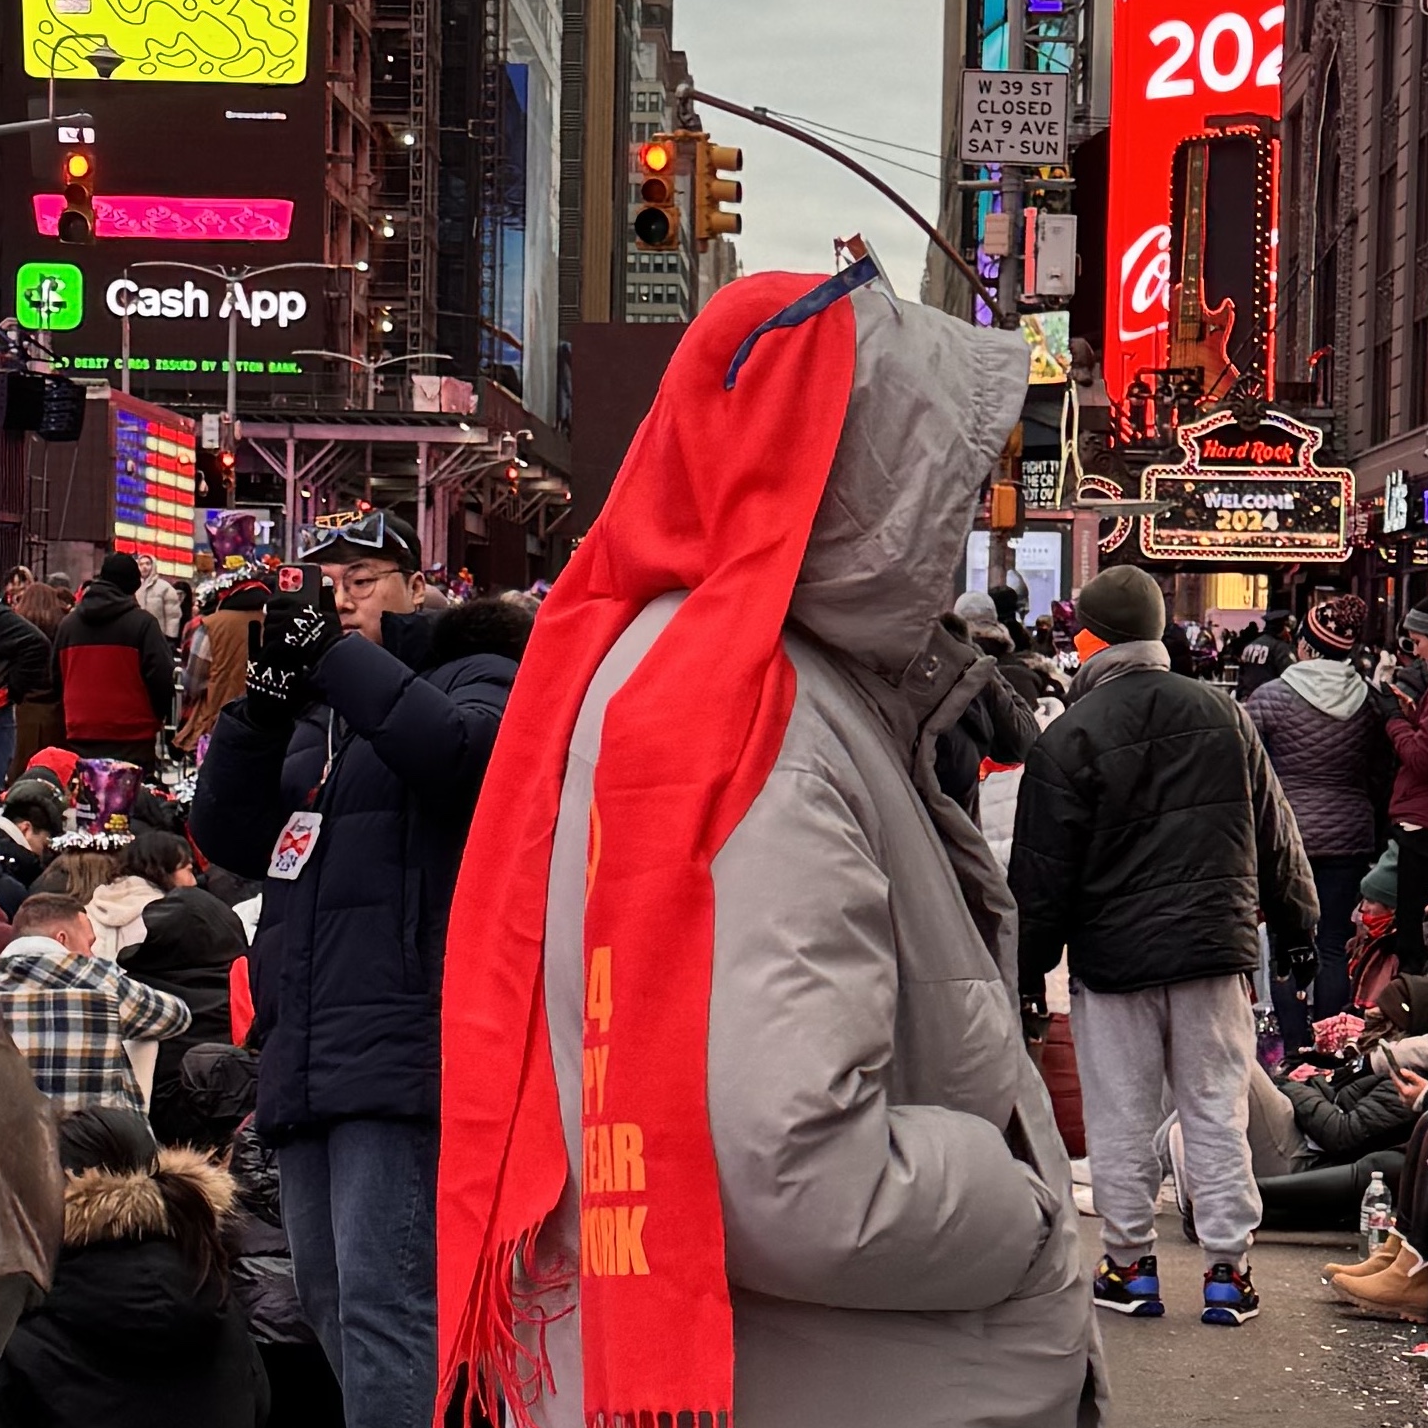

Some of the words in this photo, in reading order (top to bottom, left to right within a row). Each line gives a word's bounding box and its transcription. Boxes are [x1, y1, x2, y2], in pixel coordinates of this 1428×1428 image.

[978, 80, 993, 95] W
[999, 79, 1023, 95] 39
[1031, 81, 1054, 97] ST
[977, 99, 1052, 116] CLOSED
[969, 119, 995, 135] AT
[1002, 119, 1012, 135] 9
[1019, 120, 1059, 137] AVE
[105, 278, 210, 318] Cash
[218, 281, 307, 328] App
[1202, 439, 1249, 460] Hard
[1251, 441, 1295, 465] Rock
[1215, 510, 1280, 532] 2024
[583, 945, 613, 1034] 4
